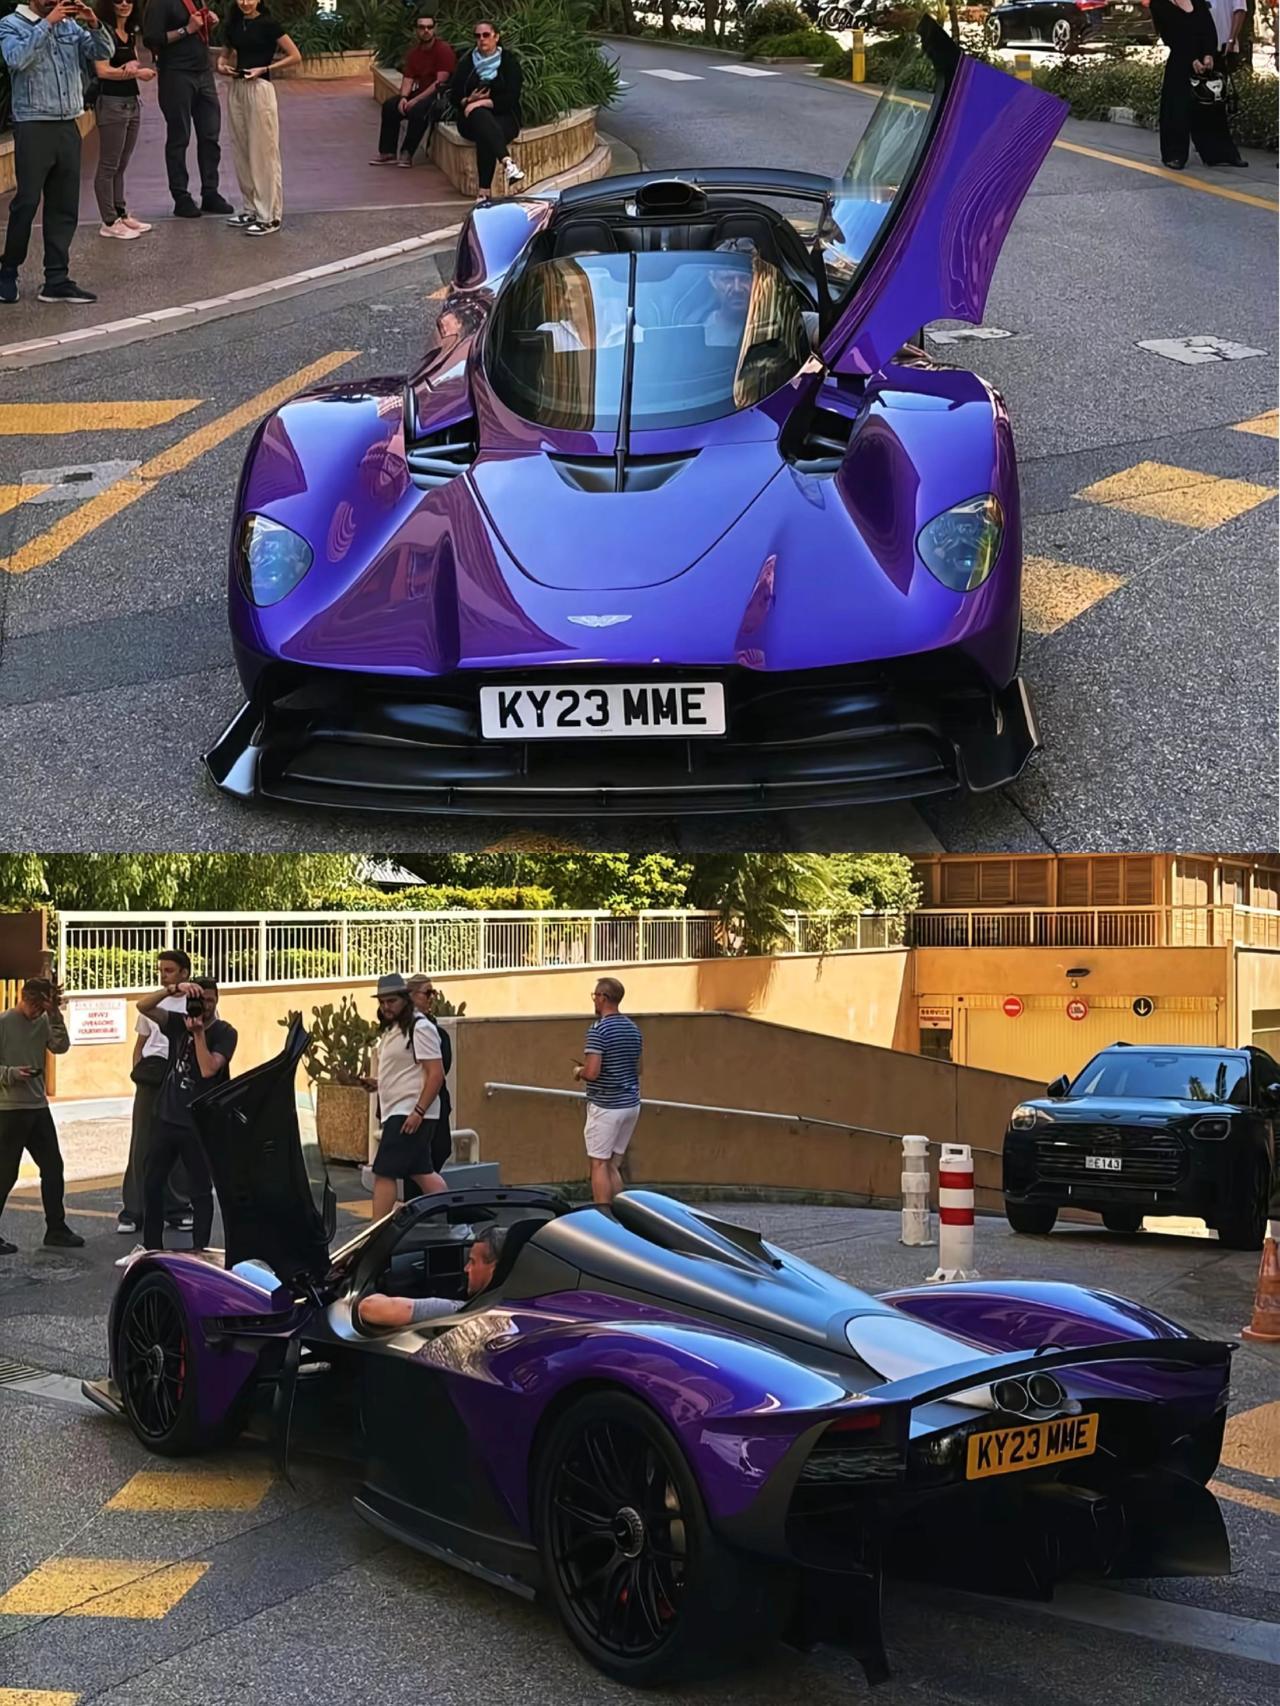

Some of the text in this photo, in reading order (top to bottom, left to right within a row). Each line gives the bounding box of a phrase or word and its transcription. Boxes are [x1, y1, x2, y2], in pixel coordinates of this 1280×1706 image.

[498, 687, 707, 728] KY23 MME
[977, 1418, 1091, 1470] KY23 MME
